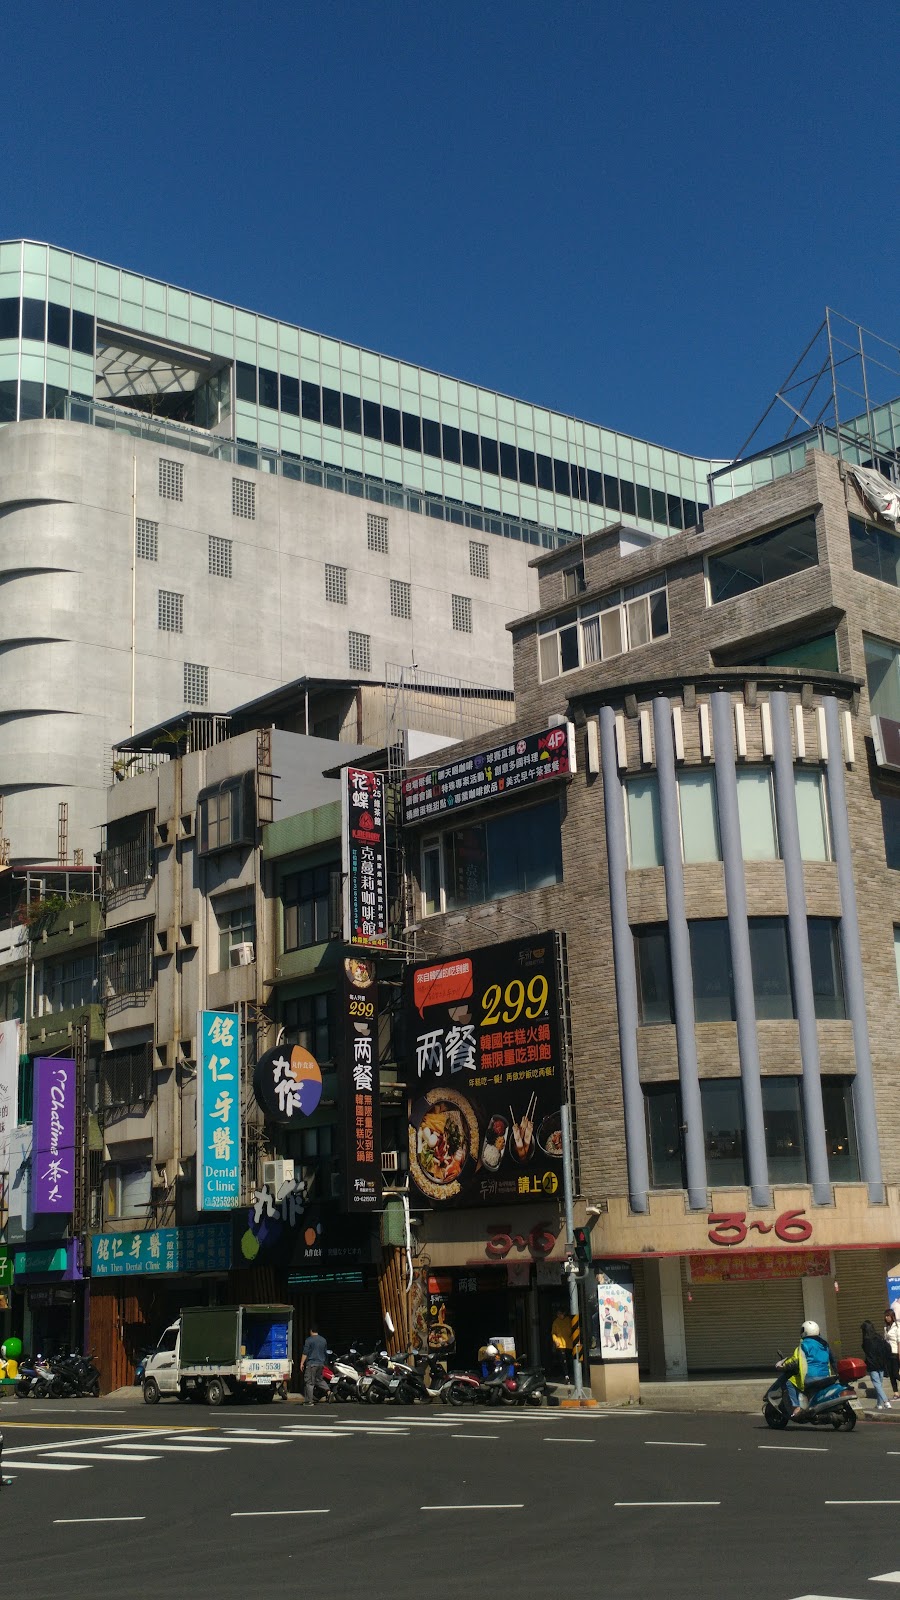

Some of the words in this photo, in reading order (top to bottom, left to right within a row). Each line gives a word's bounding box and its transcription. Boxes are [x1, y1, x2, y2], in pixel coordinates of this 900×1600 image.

[548, 731, 564, 748] 4F
[352, 772, 369, 809] 花蝶
[360, 846, 376, 936] 克蔓莉咖啡館
[349, 1001, 374, 1017] 299
[480, 975, 549, 1027] 299
[480, 1023, 551, 1051] 韓國年糕火鍋
[481, 1044, 551, 1069] 無限量吃到飽
[207, 1015, 235, 1162] 銘仁牙醫
[272, 1055, 304, 1117] 丸作
[50, 1086, 65, 1156] Chatime
[355, 1094, 365, 1162] 韓國年糕火鍋
[364, 1095, 374, 1162] 無限量吃到飽
[205, 1165, 237, 1178] Dental
[517, 1175, 542, 1194] 請上
[207, 1180, 236, 1192] Clinic
[212, 1196, 239, 1208] 5255238
[708, 1209, 813, 1246] 3~6
[96, 1232, 161, 1260] 銘仁牙醫
[96, 1264, 108, 1273] Min
[125, 1262, 142, 1271] Dental
[145, 1260, 161, 1270] Clinic
